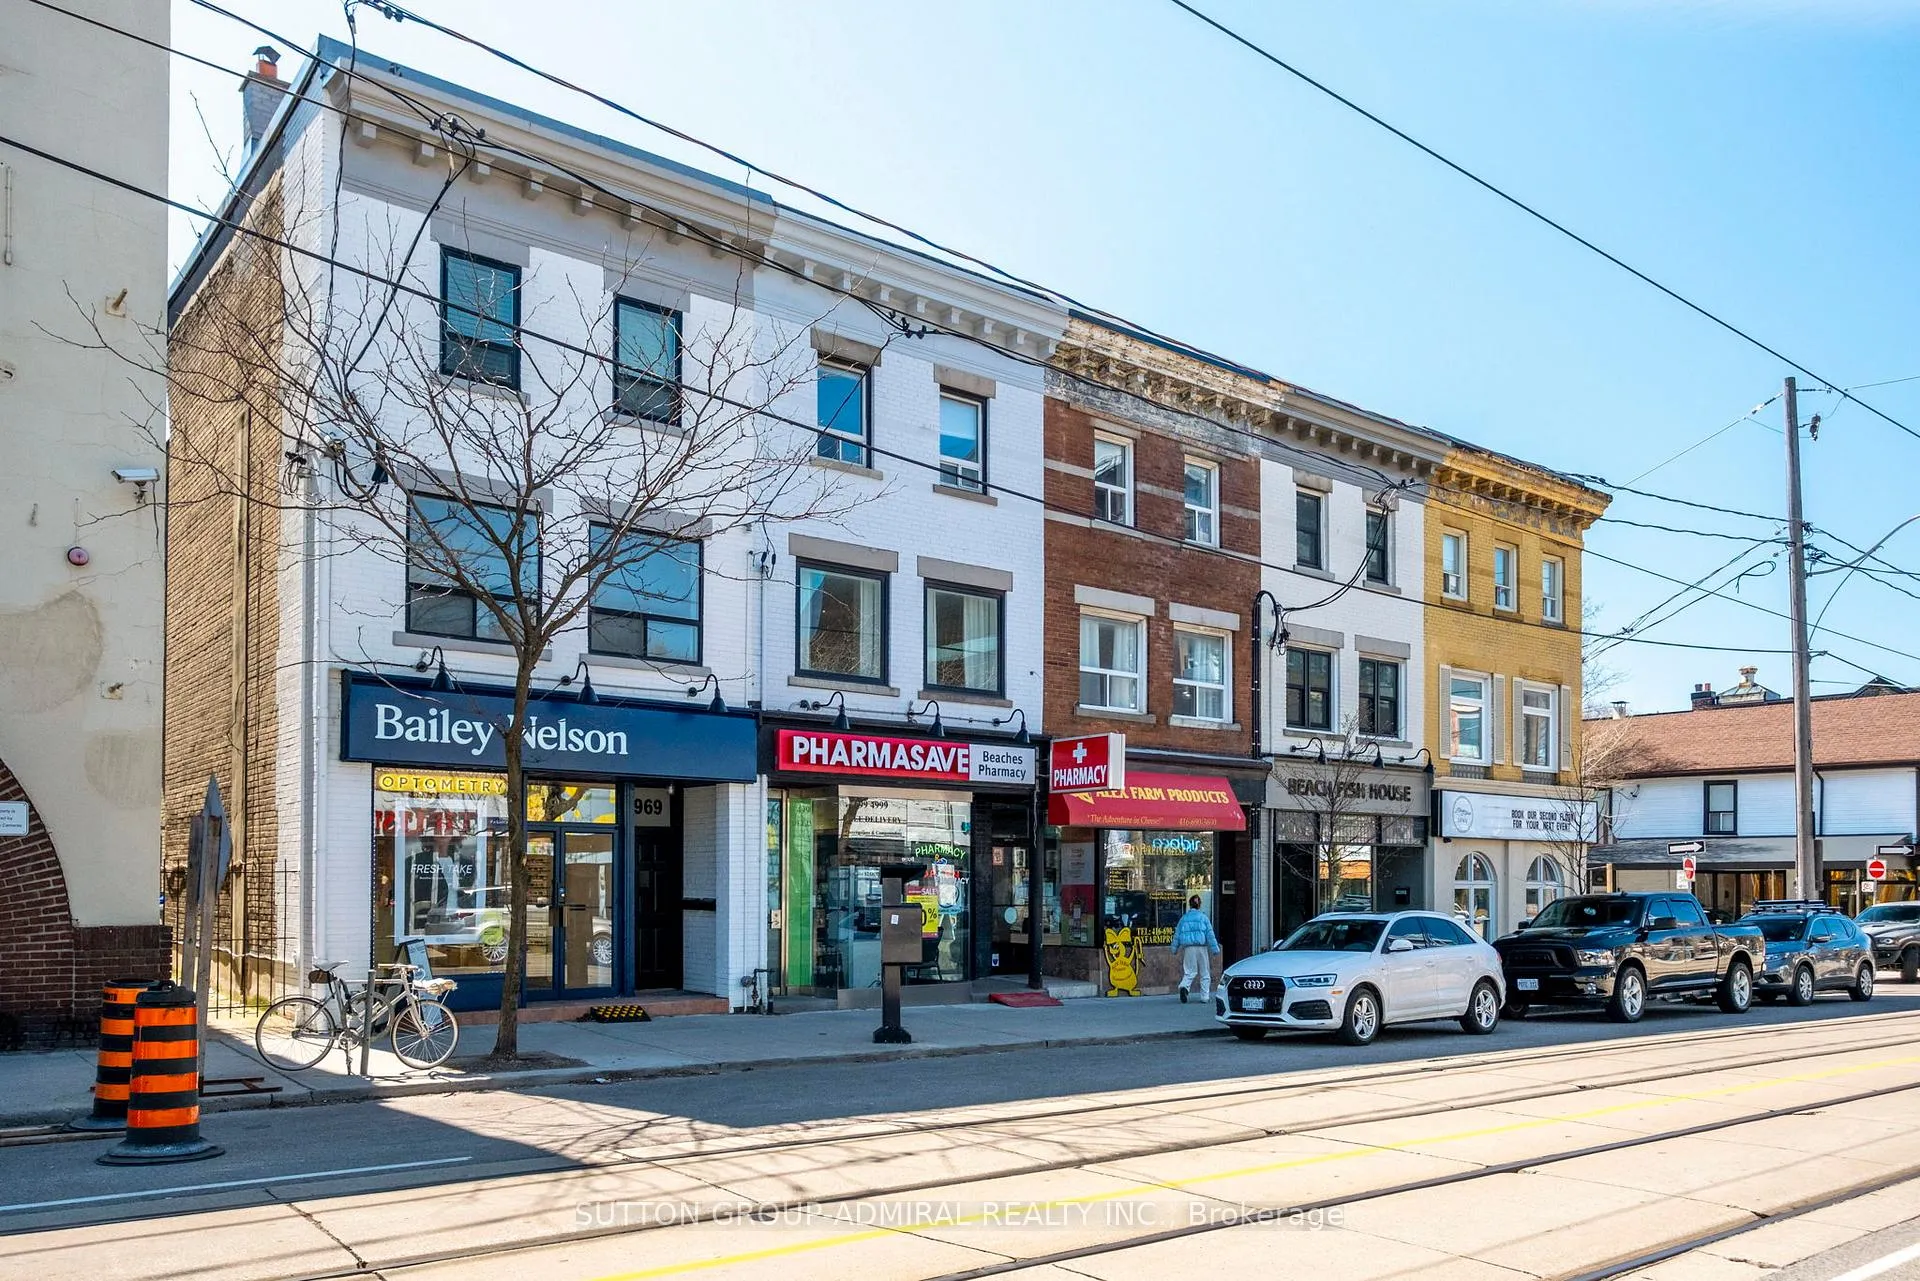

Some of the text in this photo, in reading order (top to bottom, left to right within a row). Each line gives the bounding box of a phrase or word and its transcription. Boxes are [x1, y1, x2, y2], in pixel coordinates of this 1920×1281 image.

[374, 703, 629, 756] Bailey Nelson
[792, 735, 969, 774] PHARMASAVE
[982, 750, 1024, 765] Beaches
[978, 763, 1027, 781] Pharmacy
[1053, 764, 1108, 788] PHARMACY
[382, 776, 504, 793] OPTOMETRY
[1337, 782, 1366, 799] FISH
[1369, 783, 1411, 802] HOUSE
[1129, 786, 1166, 802] FARM
[1167, 789, 1230, 804] PRODUCTS
[634, 798, 663, 815] 969
[1511, 809, 1524, 819] BOOK
[1527, 810, 1537, 820] OUR
[1539, 811, 1557, 821] SECOND
[1512, 819, 1522, 829] FOR
[1526, 820, 1539, 830] YOUR
[915, 843, 966, 859] PHARMACY
[411, 863, 444, 874] FRESH
